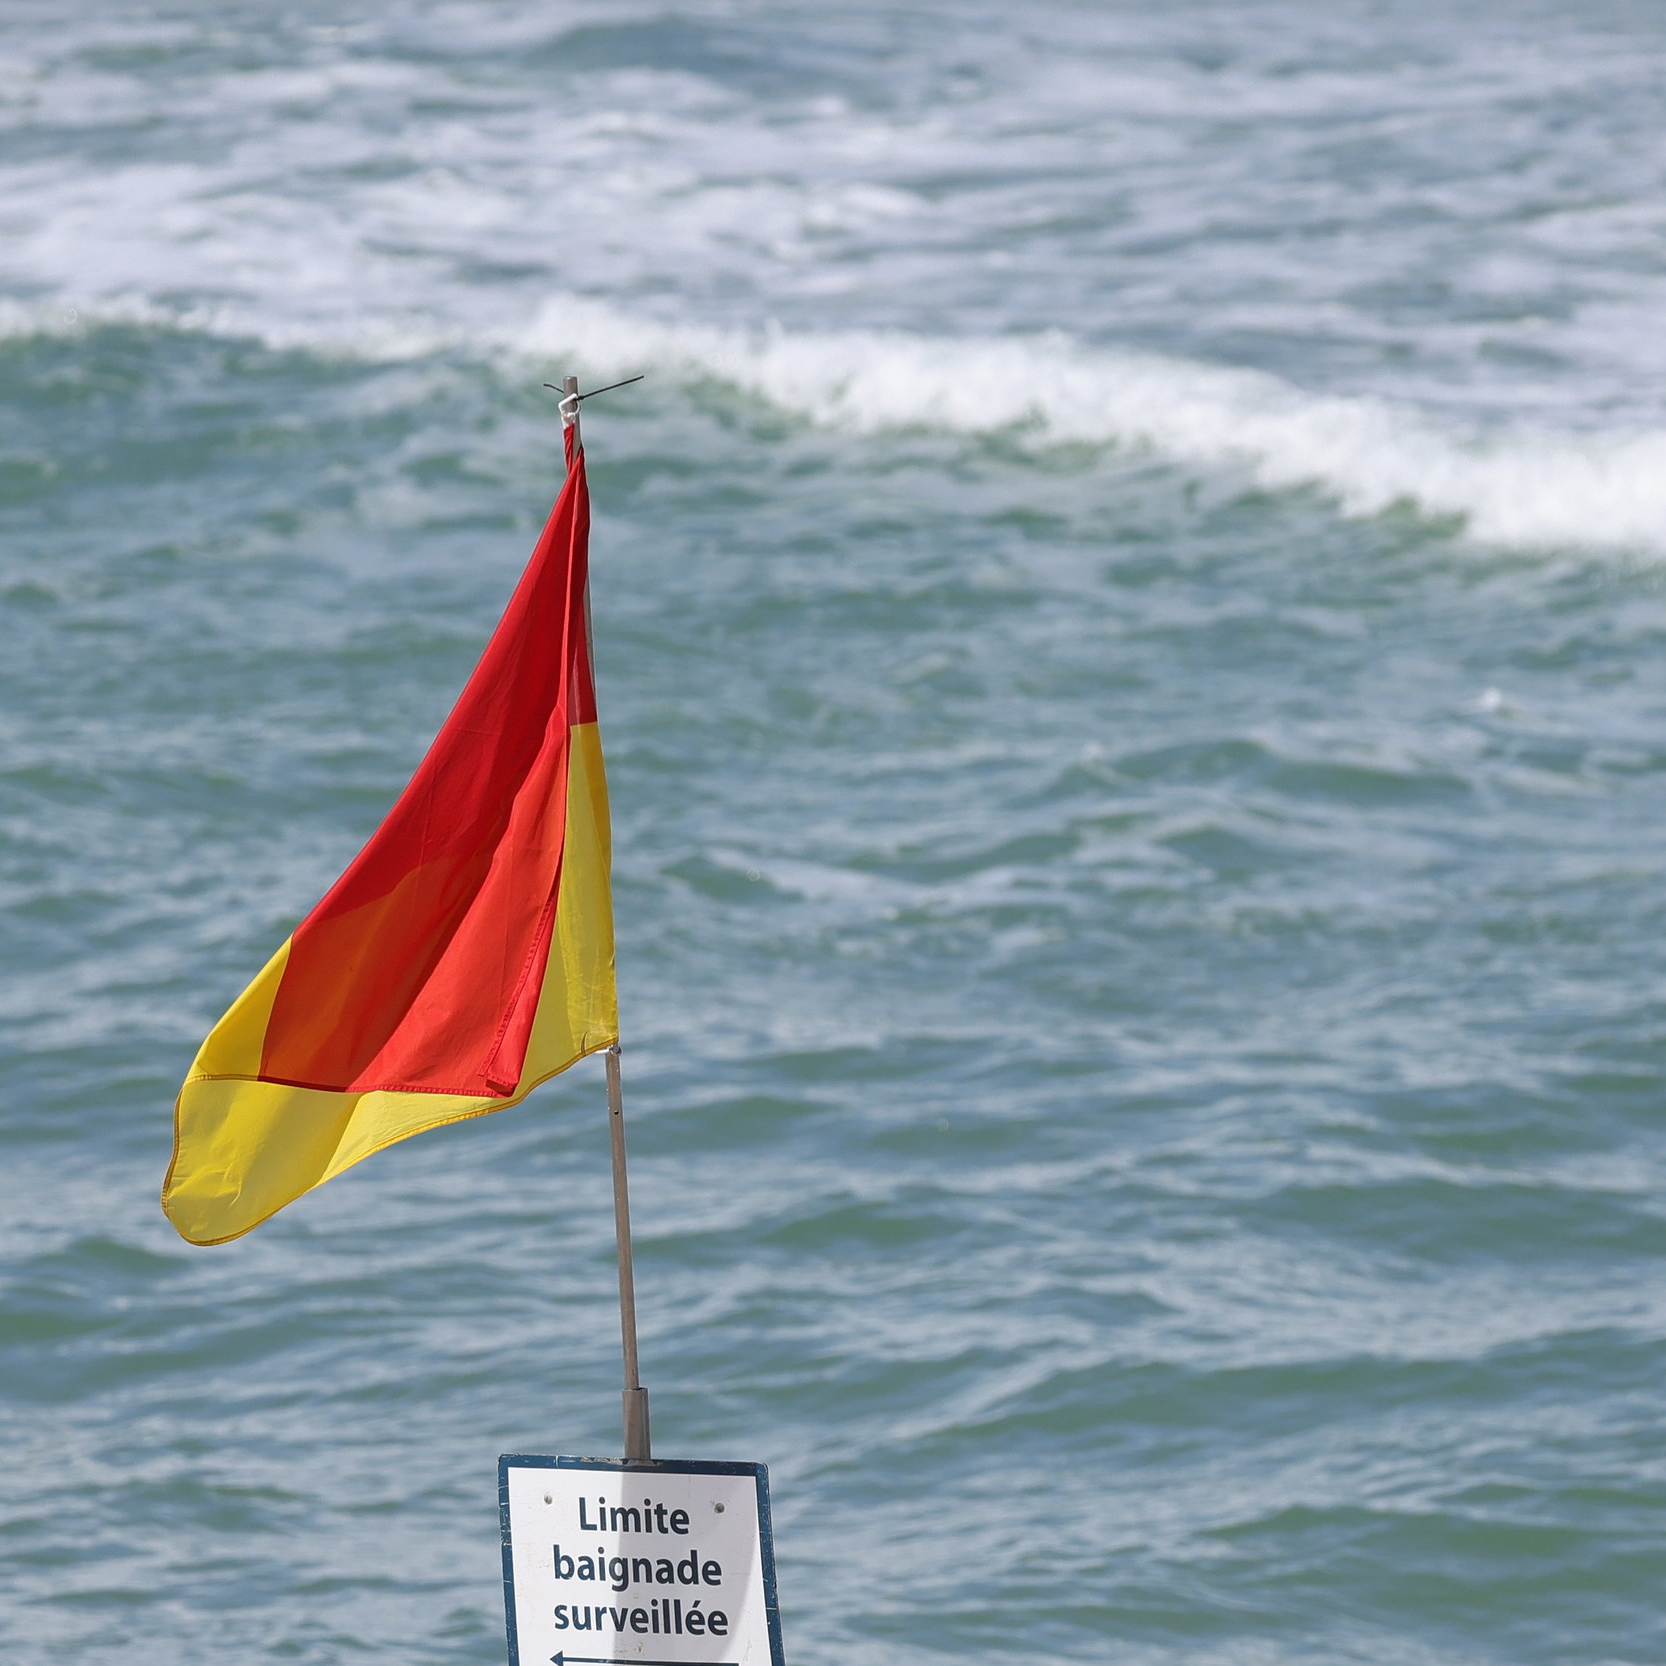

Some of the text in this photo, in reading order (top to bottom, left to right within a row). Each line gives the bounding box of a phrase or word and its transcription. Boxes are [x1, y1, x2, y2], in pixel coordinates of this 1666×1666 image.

[578, 1496, 690, 1535] Limite
[552, 1543, 723, 1592] baignade
[553, 1598, 729, 1637] surveillée
